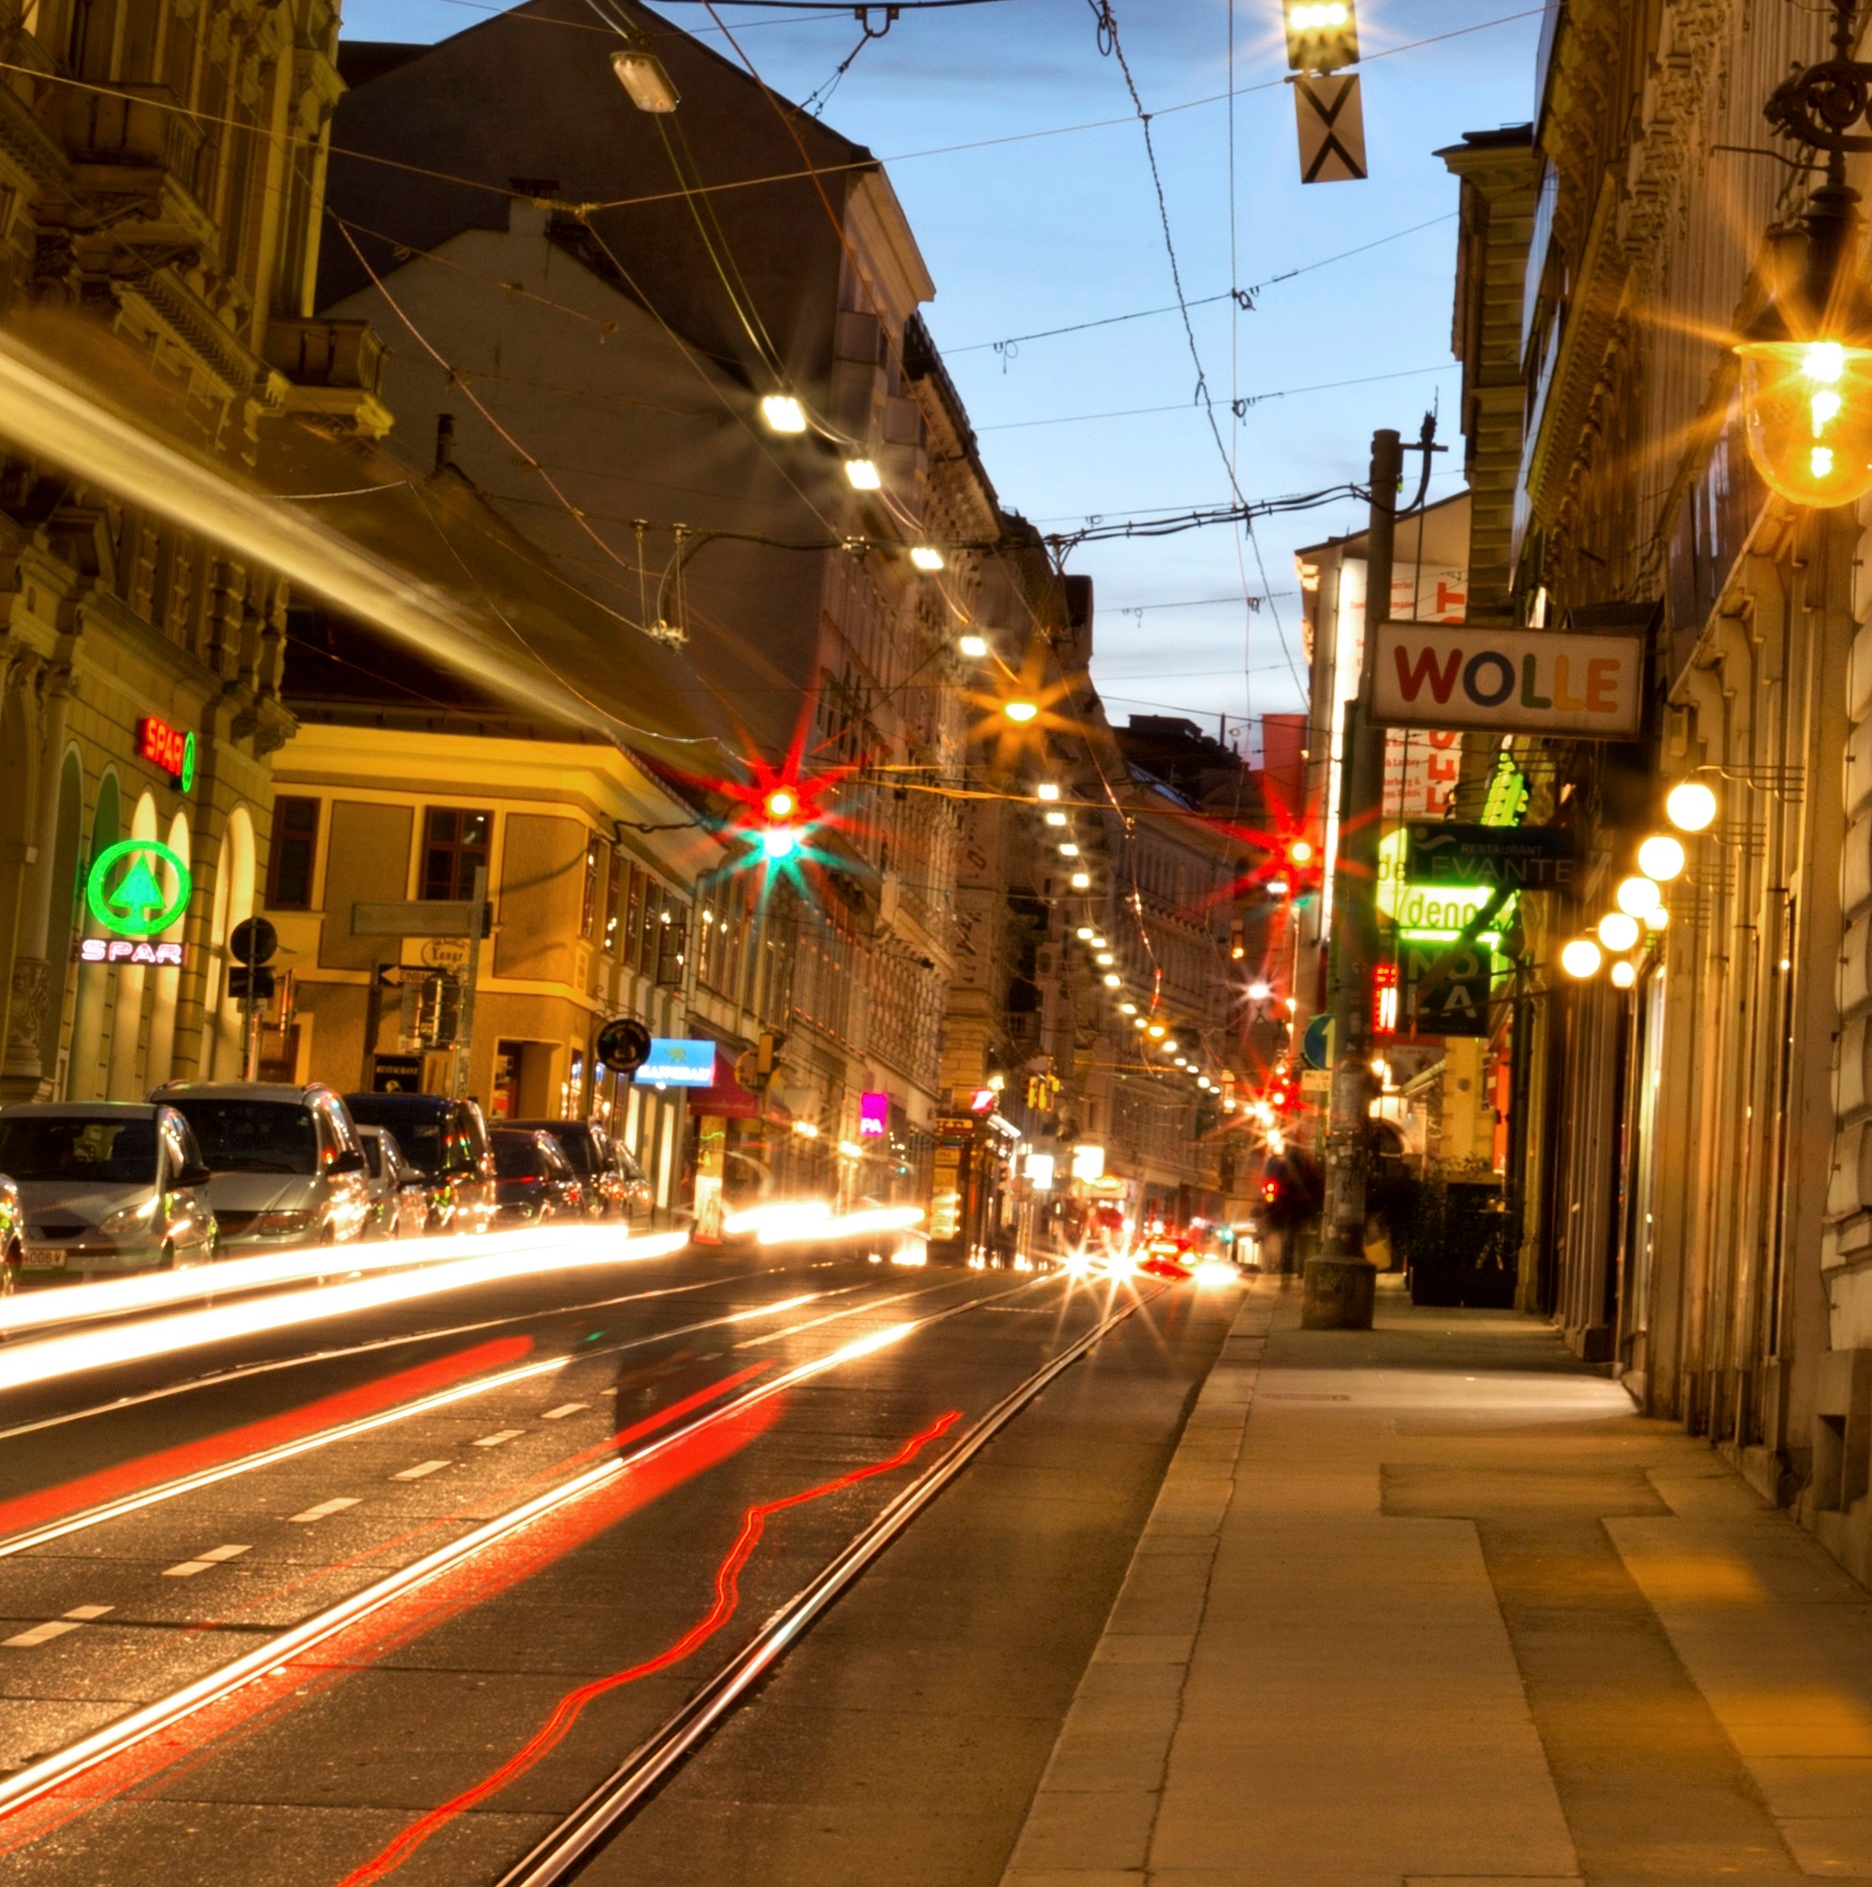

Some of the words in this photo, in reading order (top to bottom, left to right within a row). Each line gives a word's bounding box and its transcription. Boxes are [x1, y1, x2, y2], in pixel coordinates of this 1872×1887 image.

[1394, 645, 1621, 714] WOLLE
[145, 717, 183, 776] SPAR
[1461, 843, 1543, 856] RESTAURANT
[1412, 855, 1573, 883] LEVANTE
[82, 939, 181, 964] SPAR
